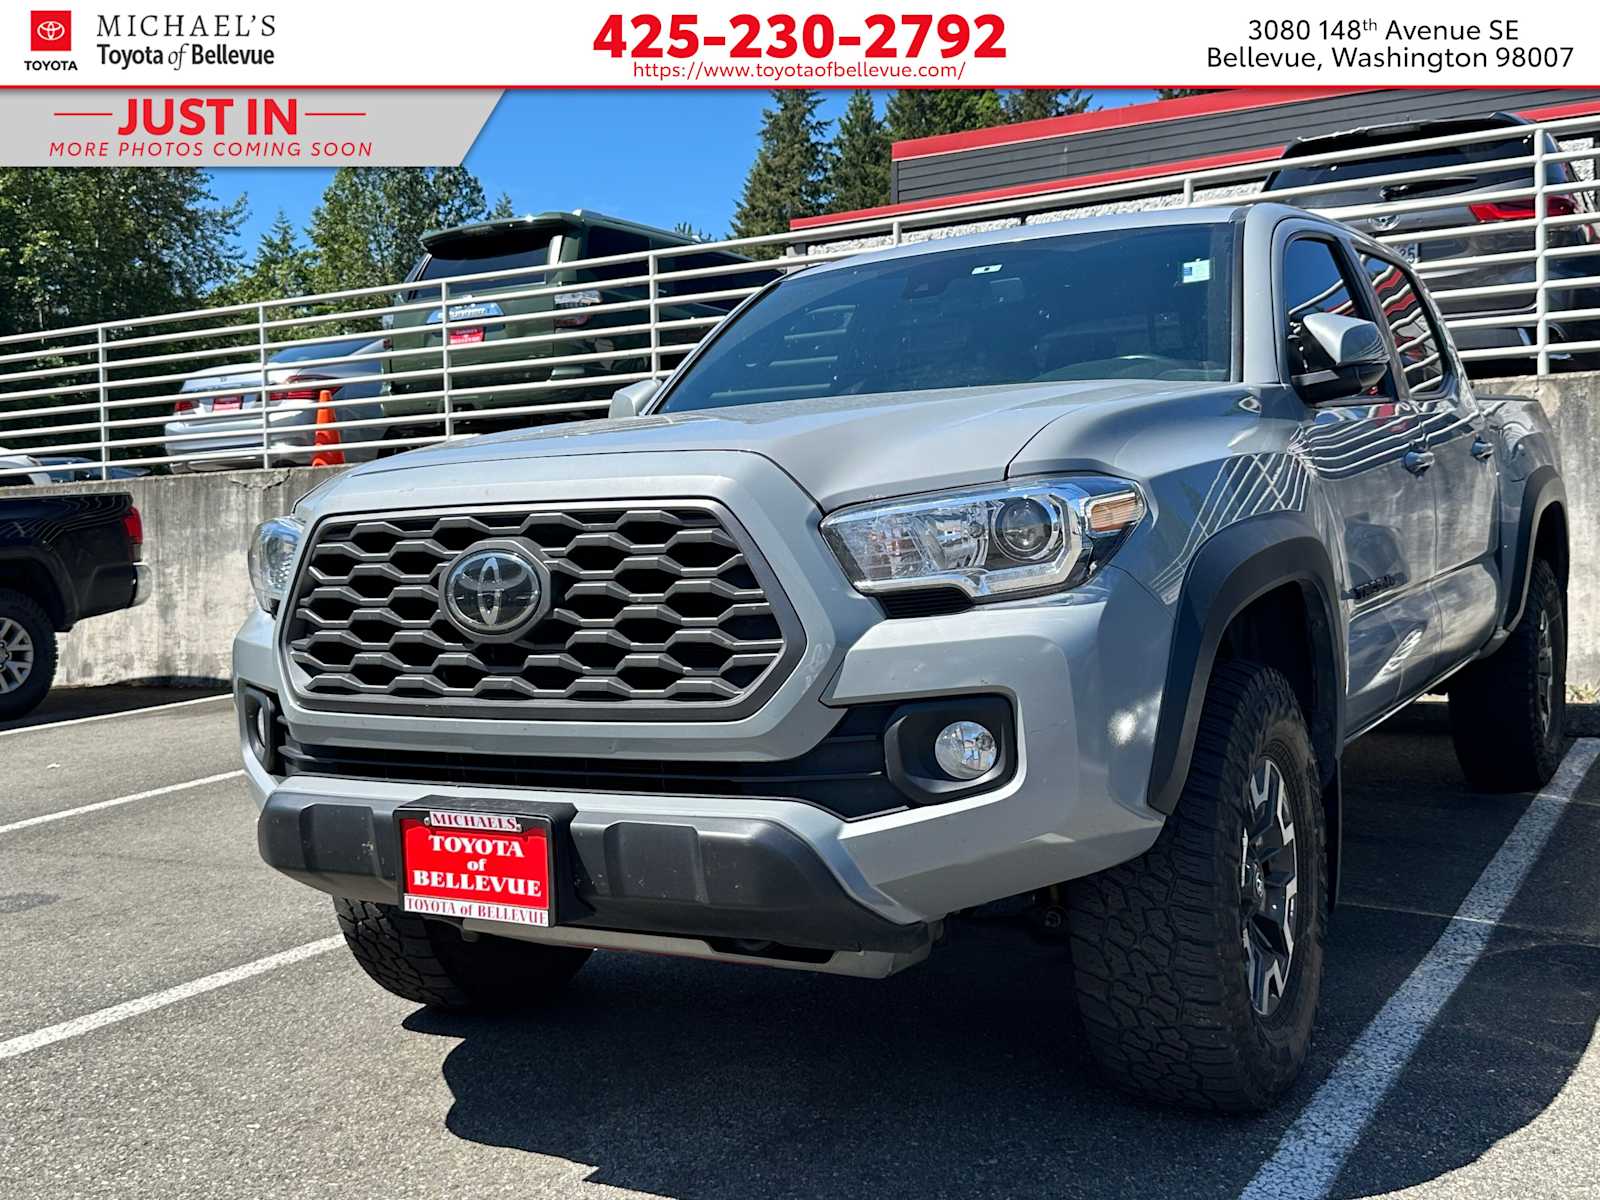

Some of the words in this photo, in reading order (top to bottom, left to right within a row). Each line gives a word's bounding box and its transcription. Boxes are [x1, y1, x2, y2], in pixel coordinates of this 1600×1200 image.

[429, 836, 524, 857] TOYOTA
[466, 858, 488, 872] of
[413, 870, 541, 897] BELLEVUE
[407, 898, 456, 915] TOYOTA
[460, 903, 473, 916] of
[478, 906, 547, 925] BELLEVUE
